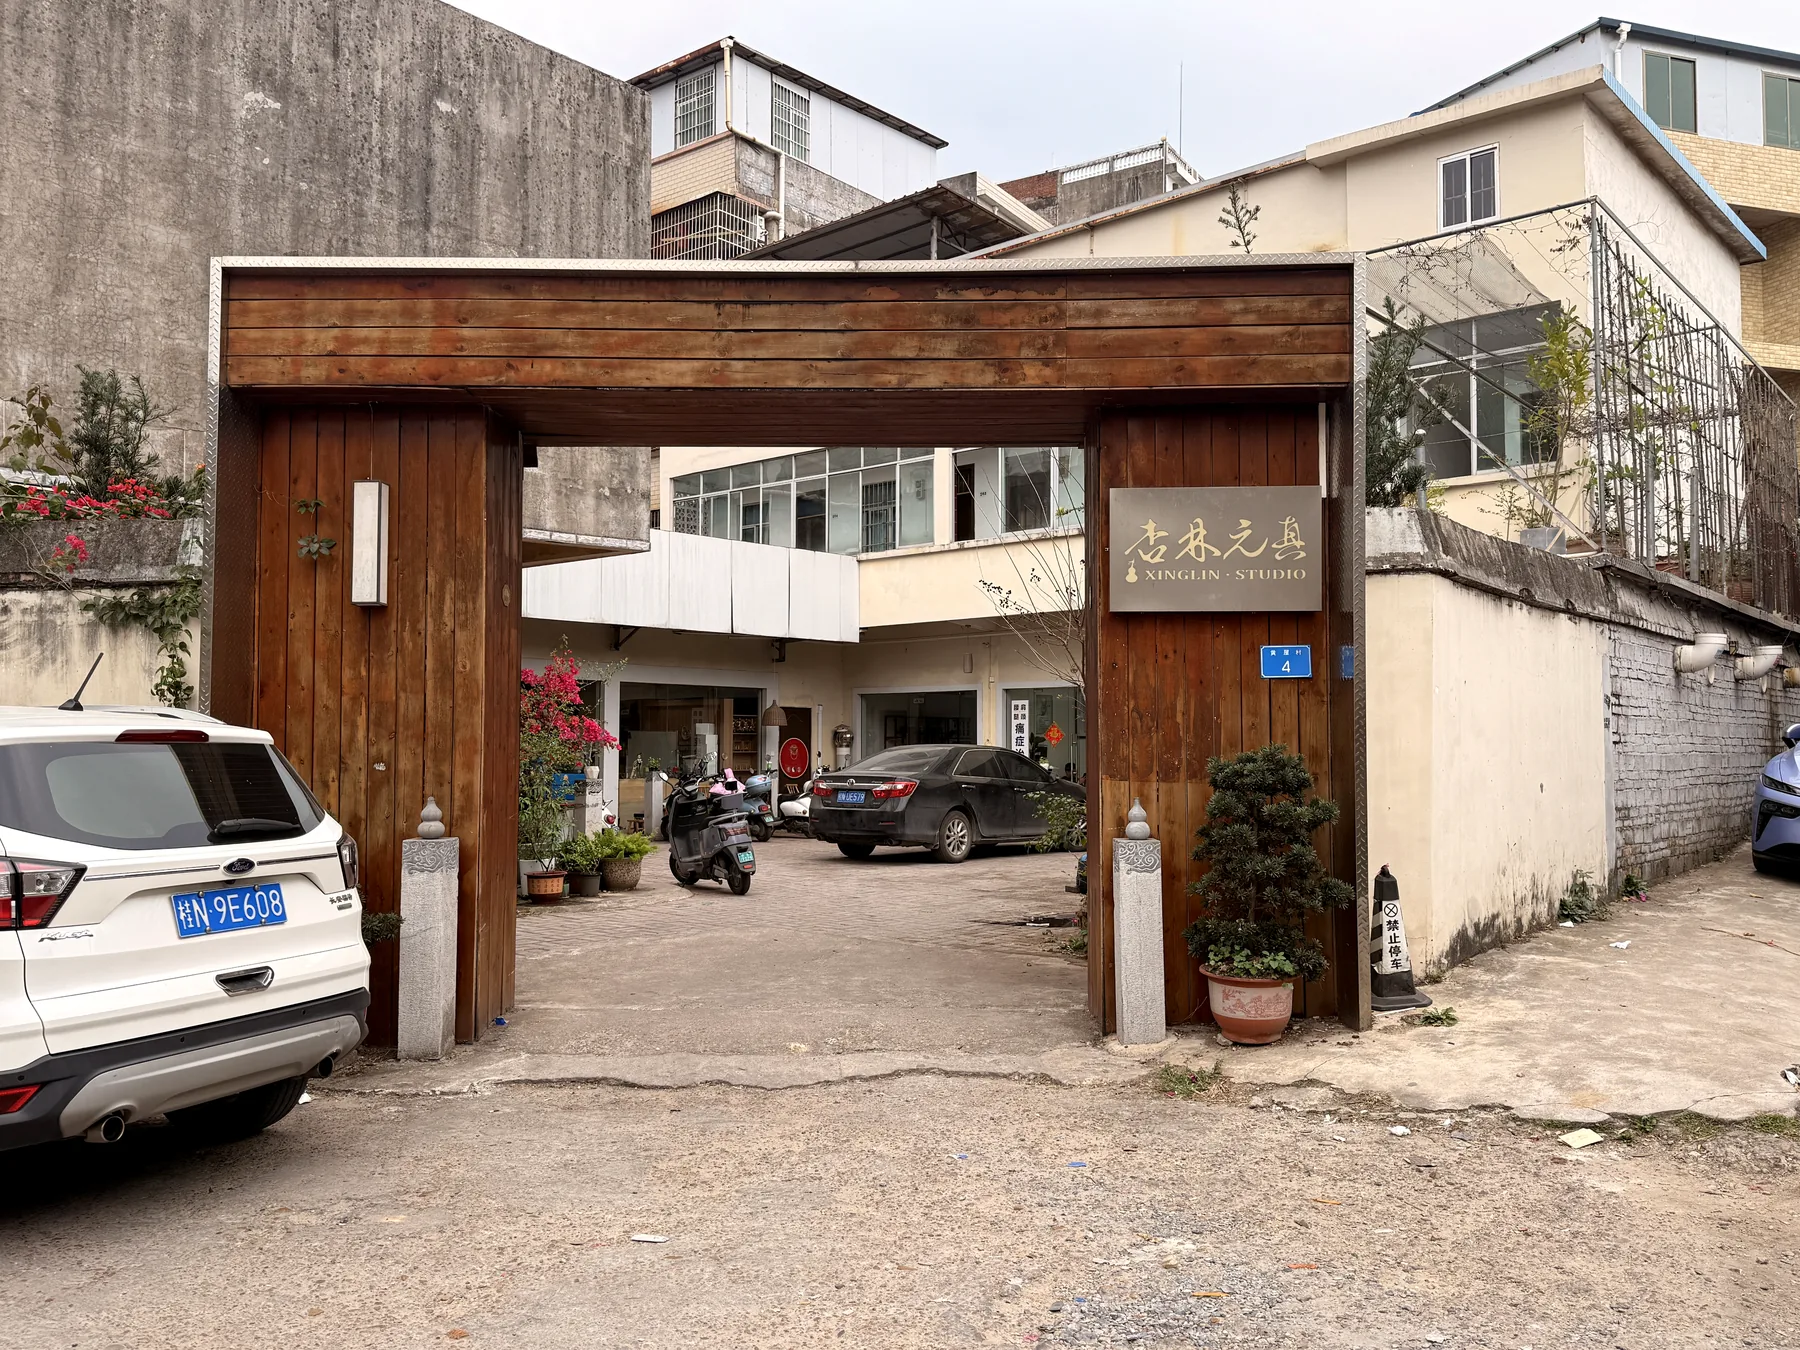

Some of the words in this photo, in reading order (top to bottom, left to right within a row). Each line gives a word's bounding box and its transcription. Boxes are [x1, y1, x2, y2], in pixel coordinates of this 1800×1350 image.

[1144, 568, 1220, 581] XINGLIN
[1235, 568, 1306, 581] STUDIO
[1281, 660, 1291, 673] 4
[1386, 919, 1403, 970] 禁止停车
